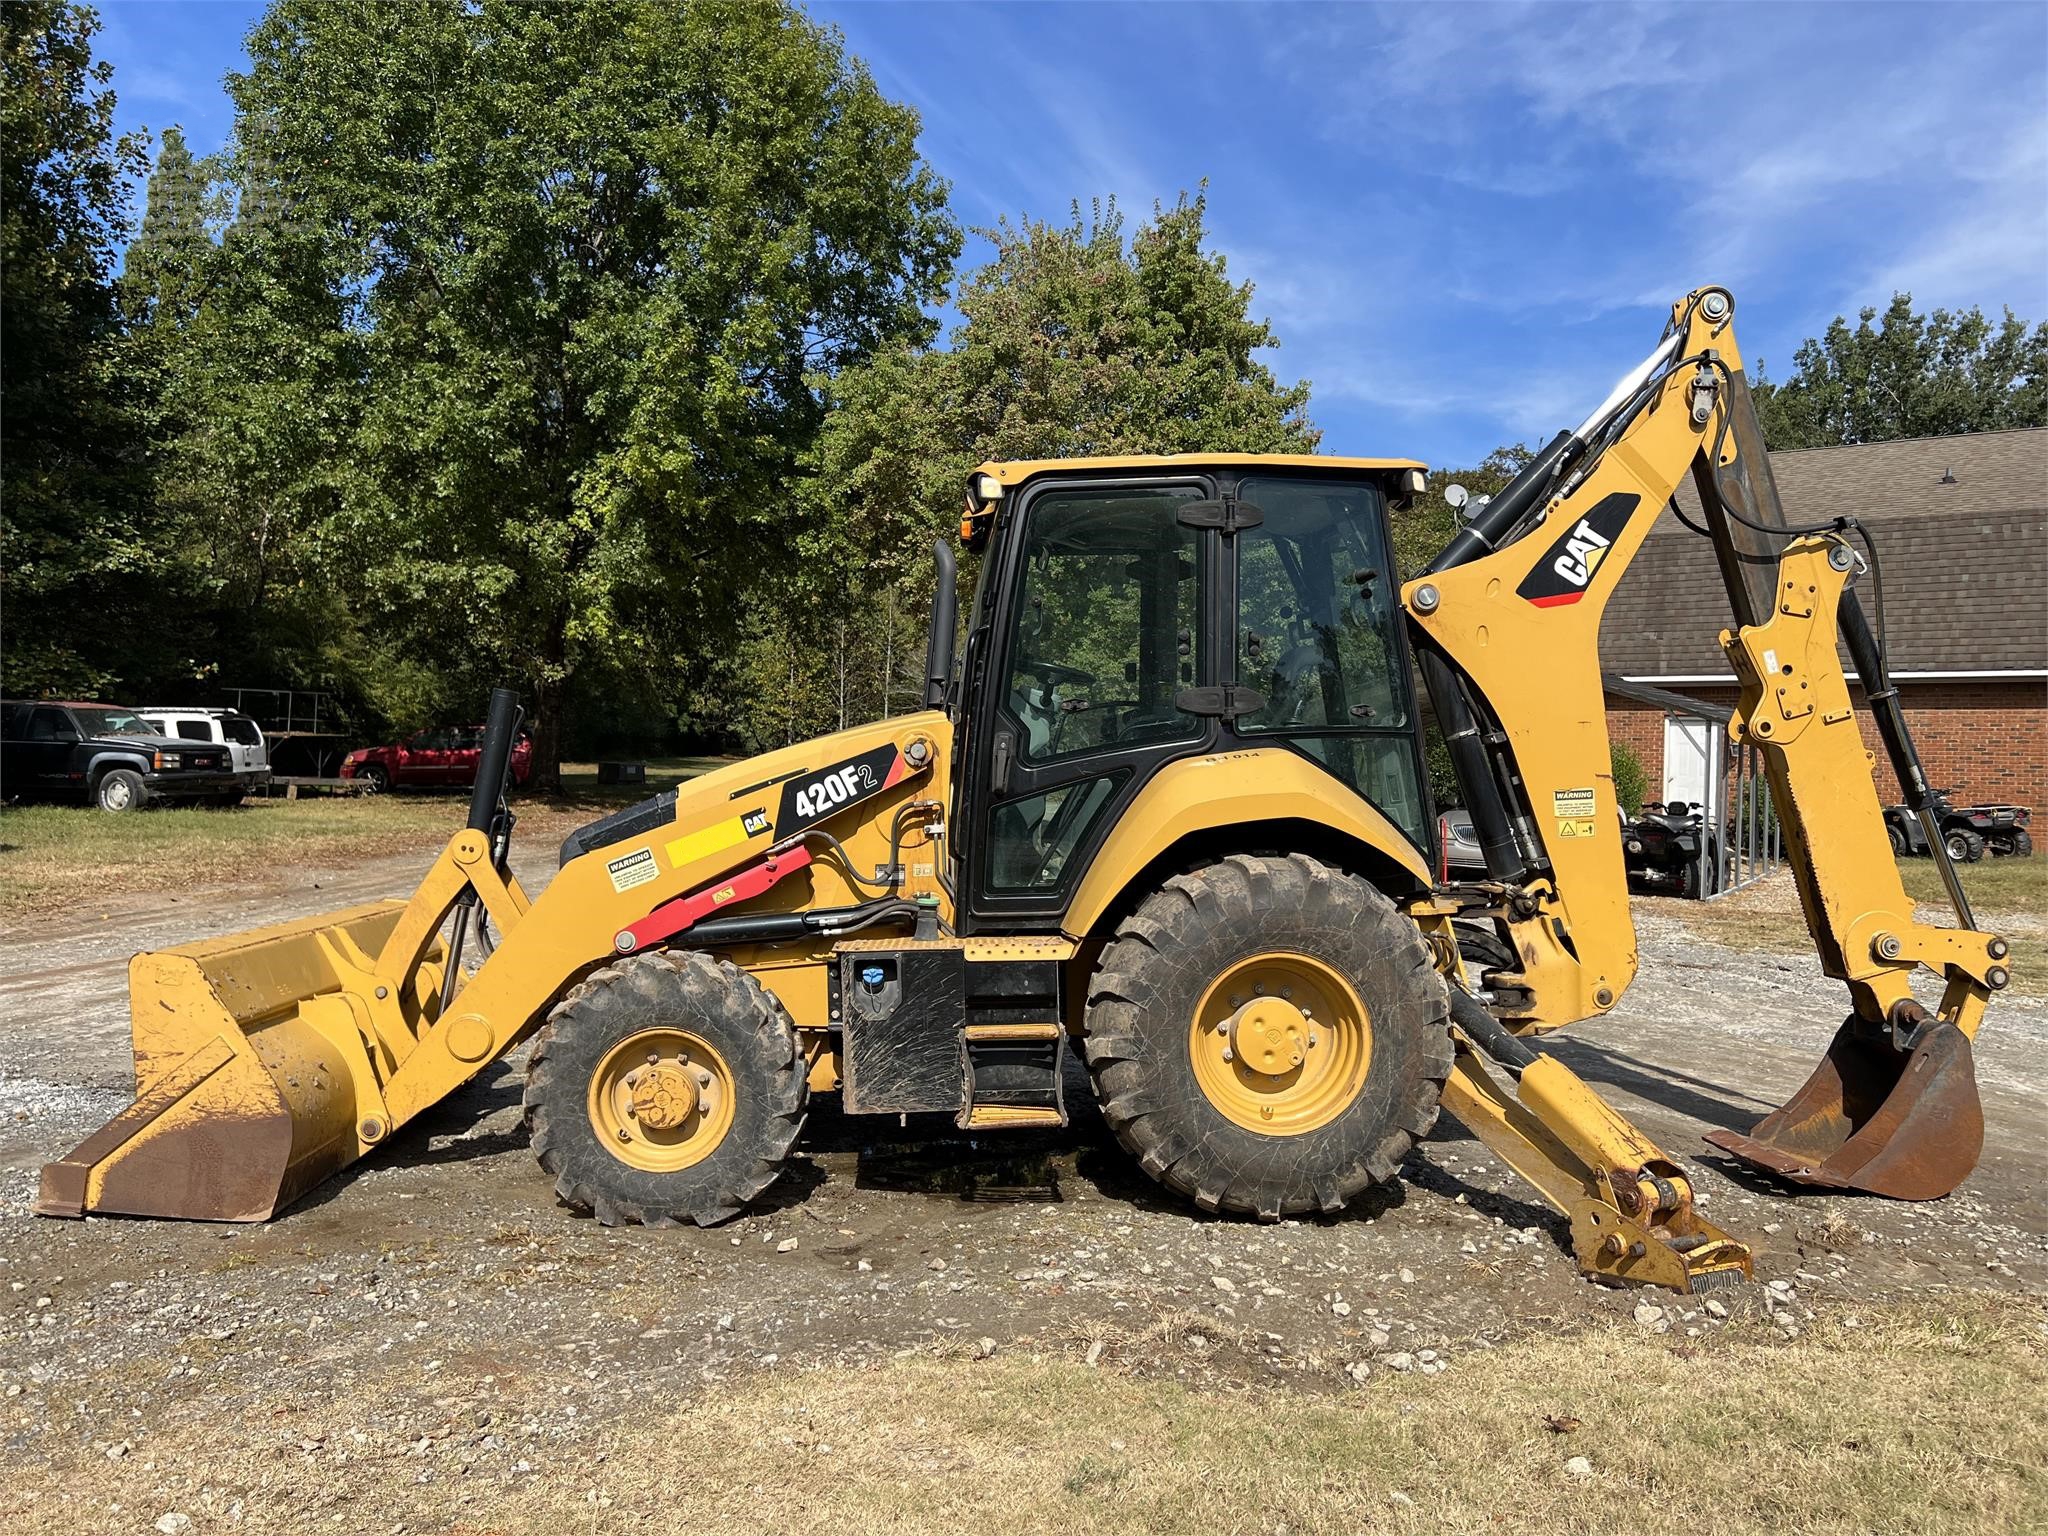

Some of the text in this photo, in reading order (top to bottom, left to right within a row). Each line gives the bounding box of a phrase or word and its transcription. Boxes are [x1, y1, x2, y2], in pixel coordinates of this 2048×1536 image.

[1554, 519, 1610, 586] CAT
[1556, 791, 1592, 800] WARNING
[744, 812, 768, 833] CAT
[610, 851, 650, 872] WARNING
